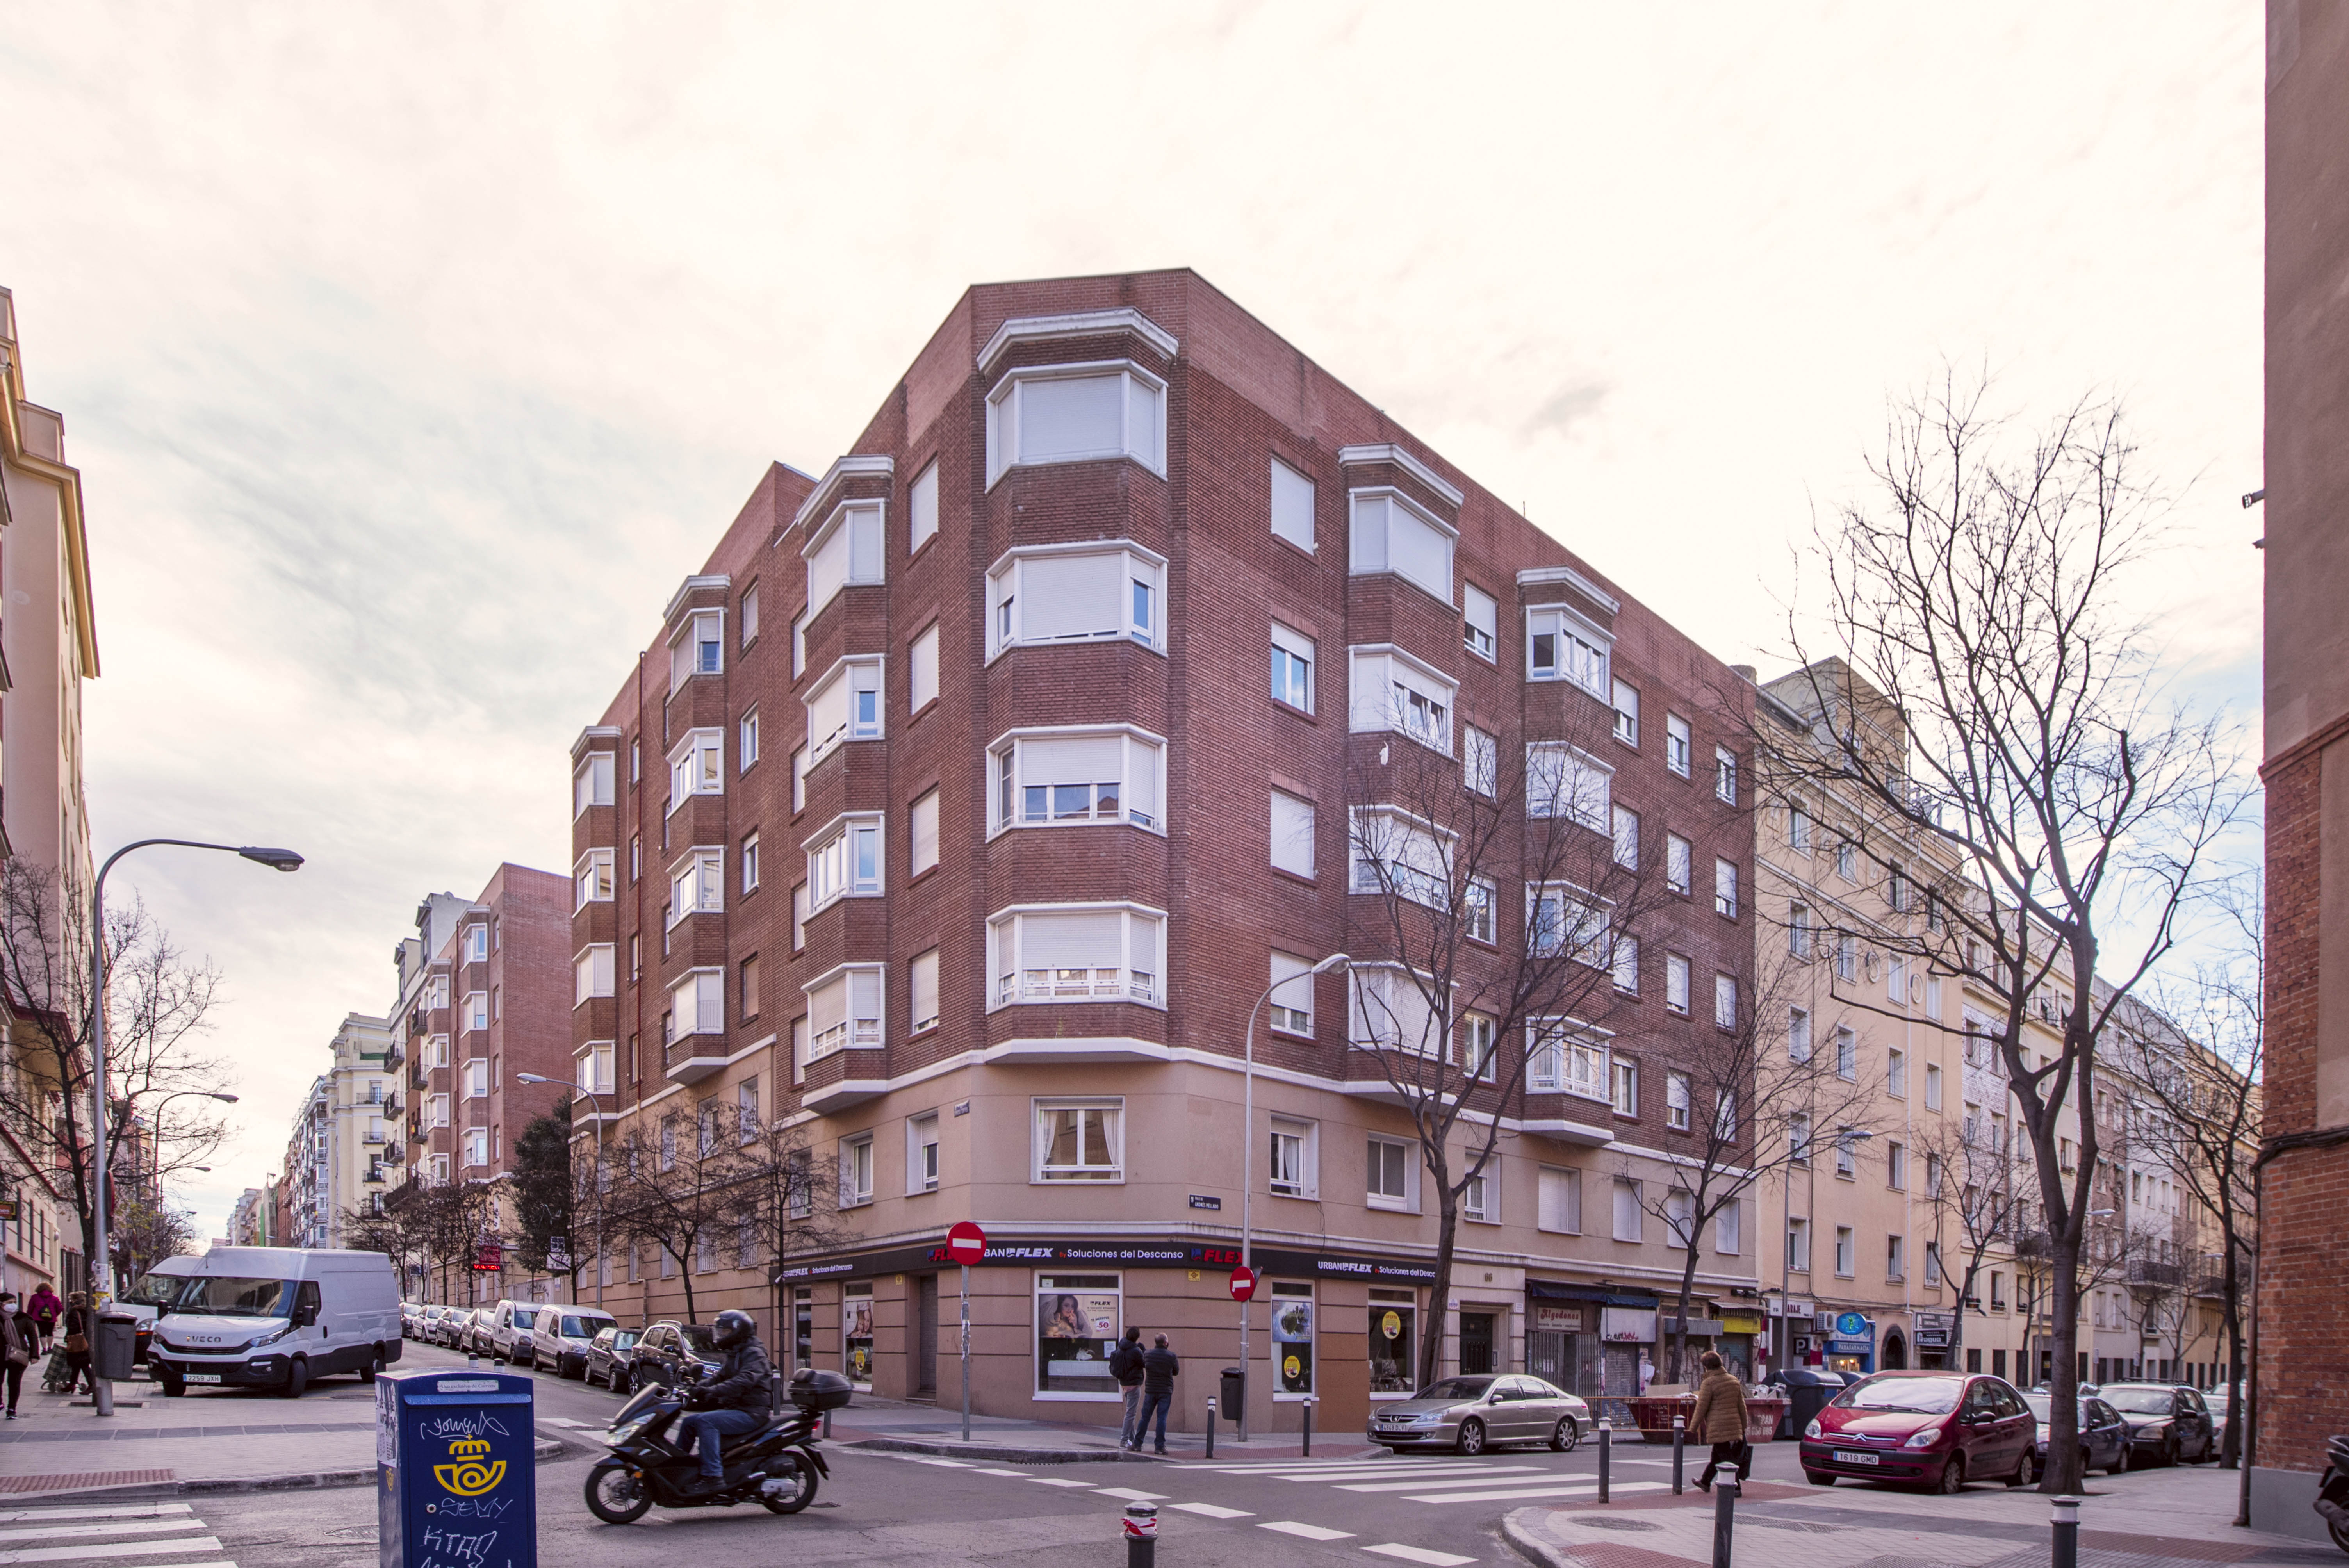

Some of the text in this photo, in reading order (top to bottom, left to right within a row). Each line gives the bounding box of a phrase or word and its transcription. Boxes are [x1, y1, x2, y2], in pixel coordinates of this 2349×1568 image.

[984, 1248, 1005, 1258] BAN
[1016, 1248, 1053, 1258] FLEX
[1067, 1249, 1117, 1257] Soluciones
[1120, 1250, 1135, 1258] del
[1137, 1249, 1183, 1258] Descanso
[1318, 1261, 1342, 1270] URBAN
[1348, 1263, 1372, 1273] FLEX
[1379, 1266, 1409, 1276] Soluciones
[1485, 1273, 1493, 1282] 66
[1541, 1308, 1579, 1321] Algodones
[1788, 1304, 1801, 1314] ARAJE
[1796, 1339, 1806, 1354] P
[1840, 1453, 1877, 1464] 1619 GMD
